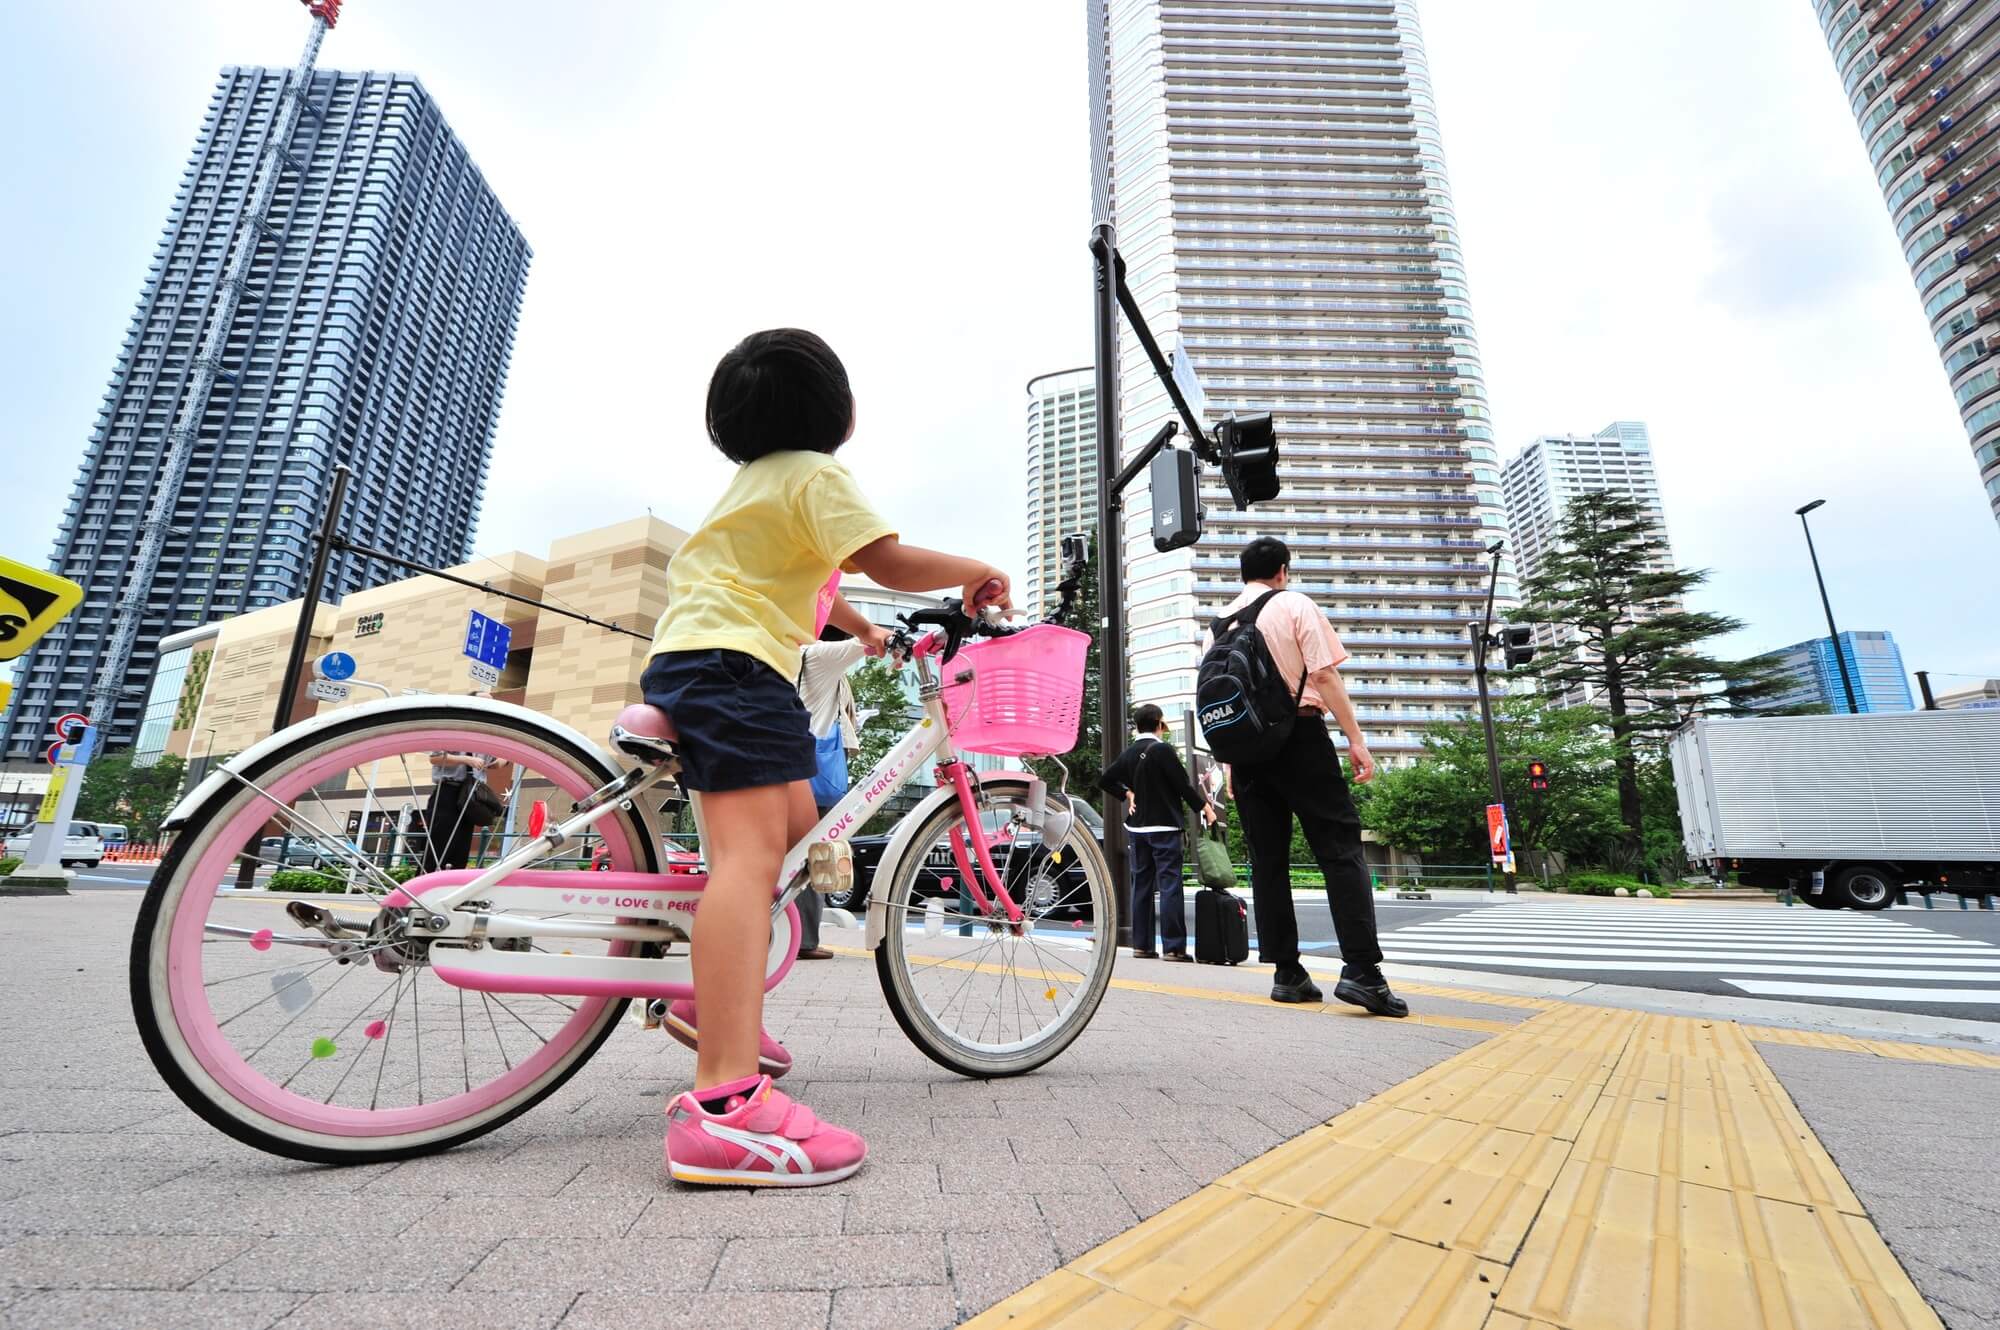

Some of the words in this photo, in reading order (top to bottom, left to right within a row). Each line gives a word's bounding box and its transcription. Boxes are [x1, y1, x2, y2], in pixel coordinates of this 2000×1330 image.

[358, 612, 384, 625] GRAND
[357, 621, 377, 633] TREE
[472, 666, 497, 682] ここから
[316, 683, 347, 697] ここから
[1202, 704, 1234, 725] JOOLA
[821, 812, 855, 842] OVE
[864, 767, 898, 802] PEACE
[928, 852, 950, 865] TAXI
[615, 897, 649, 909] LOVE
[667, 900, 699, 912] PEAC
